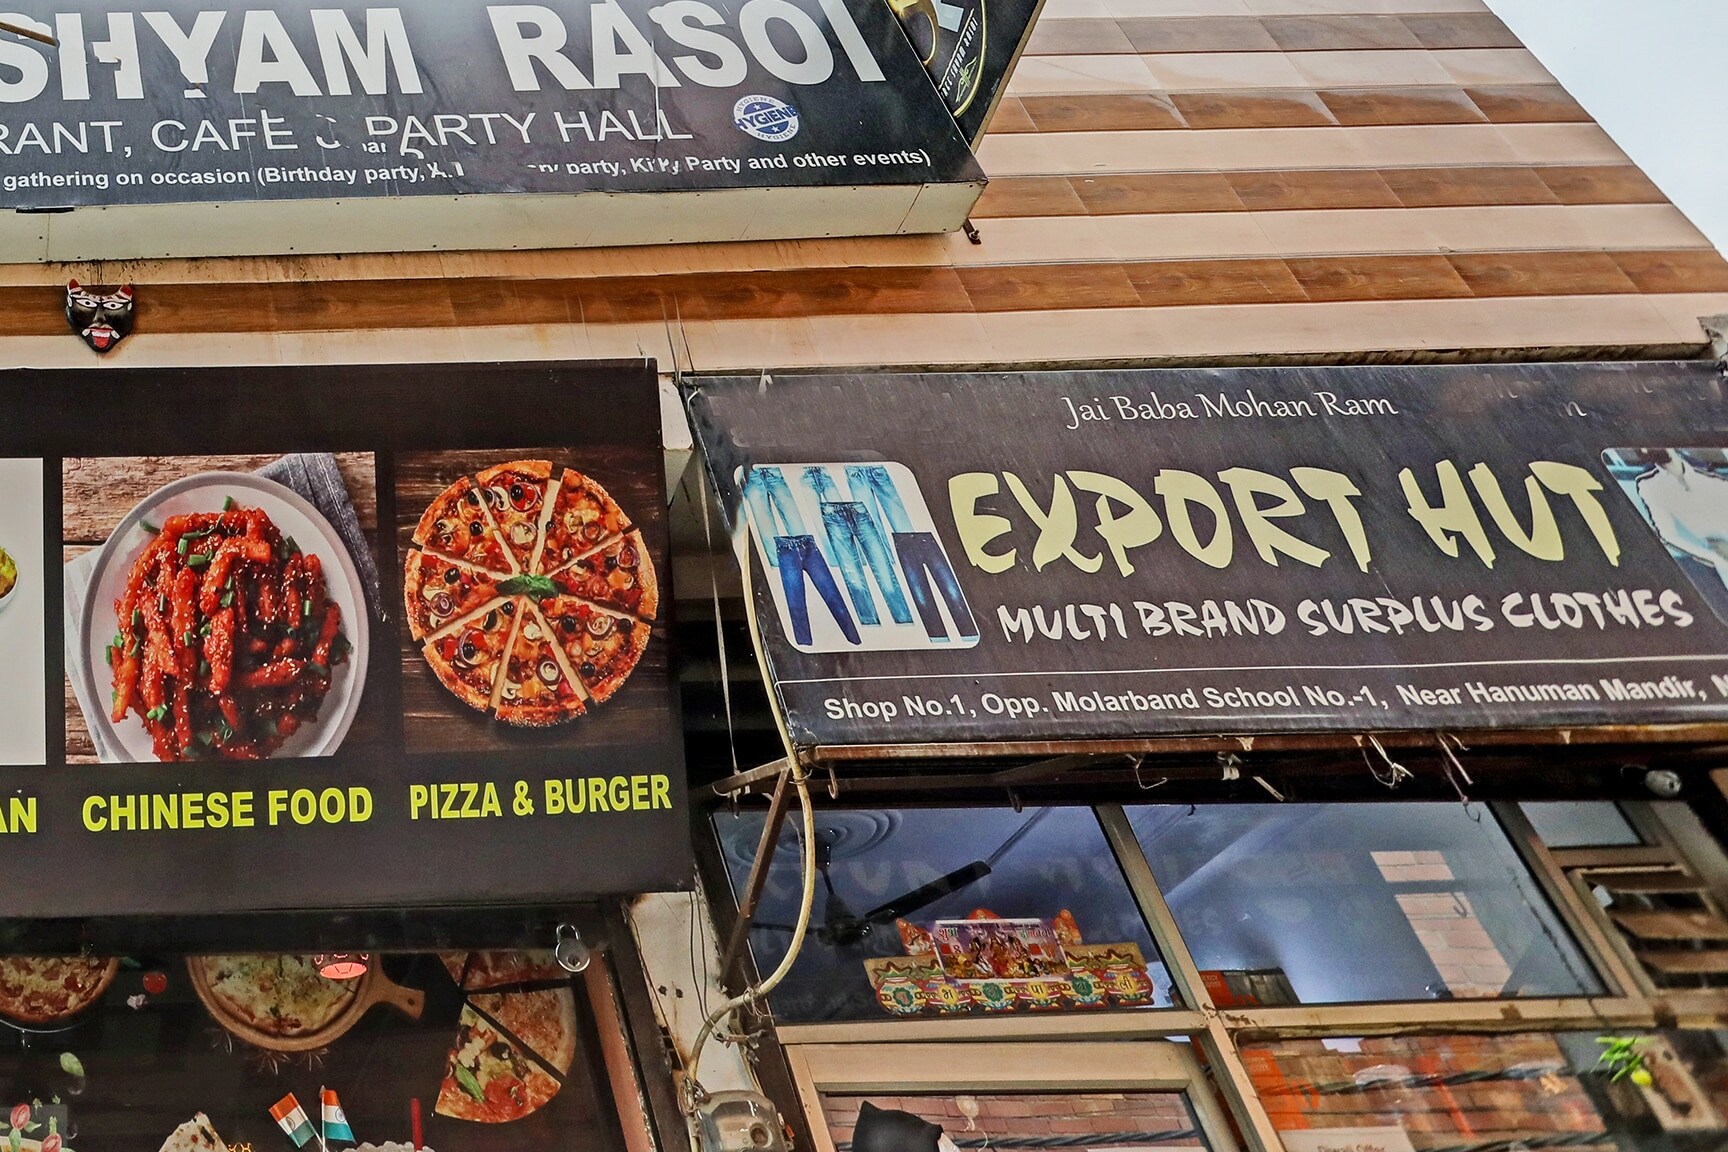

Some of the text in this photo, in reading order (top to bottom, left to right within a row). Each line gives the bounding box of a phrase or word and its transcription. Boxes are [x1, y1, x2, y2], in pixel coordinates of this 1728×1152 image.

[554, 108, 693, 143] HALL
[734, 105, 801, 130] HYGIENE
[3, 170, 109, 191] gathering
[116, 171, 144, 186] on
[150, 168, 250, 186] occasion
[257, 165, 357, 188] (Birthday
[364, 164, 425, 185] party,
[685, 155, 741, 174] Party
[747, 153, 787, 170] and
[793, 151, 847, 168] other
[854, 148, 932, 167] events)
[1061, 389, 1399, 429] Jai Baba Mohan Ram
[948, 459, 1621, 578] EXPORT HUT
[996, 588, 1694, 644] MULTI BRAND SURPLUS CLOTHES
[823, 695, 898, 722] Shop
[981, 692, 1049, 719] Opp.
[1053, 688, 1201, 712] Molarband
[1201, 686, 1298, 709] School
[1396, 684, 1462, 706] Near
[1468, 681, 1601, 704] Hanuman
[1599, 675, 1708, 702] Mandir,
[82, 786, 373, 832] CHINESE FOOD
[410, 774, 673, 820] PIZZA & BURGER
